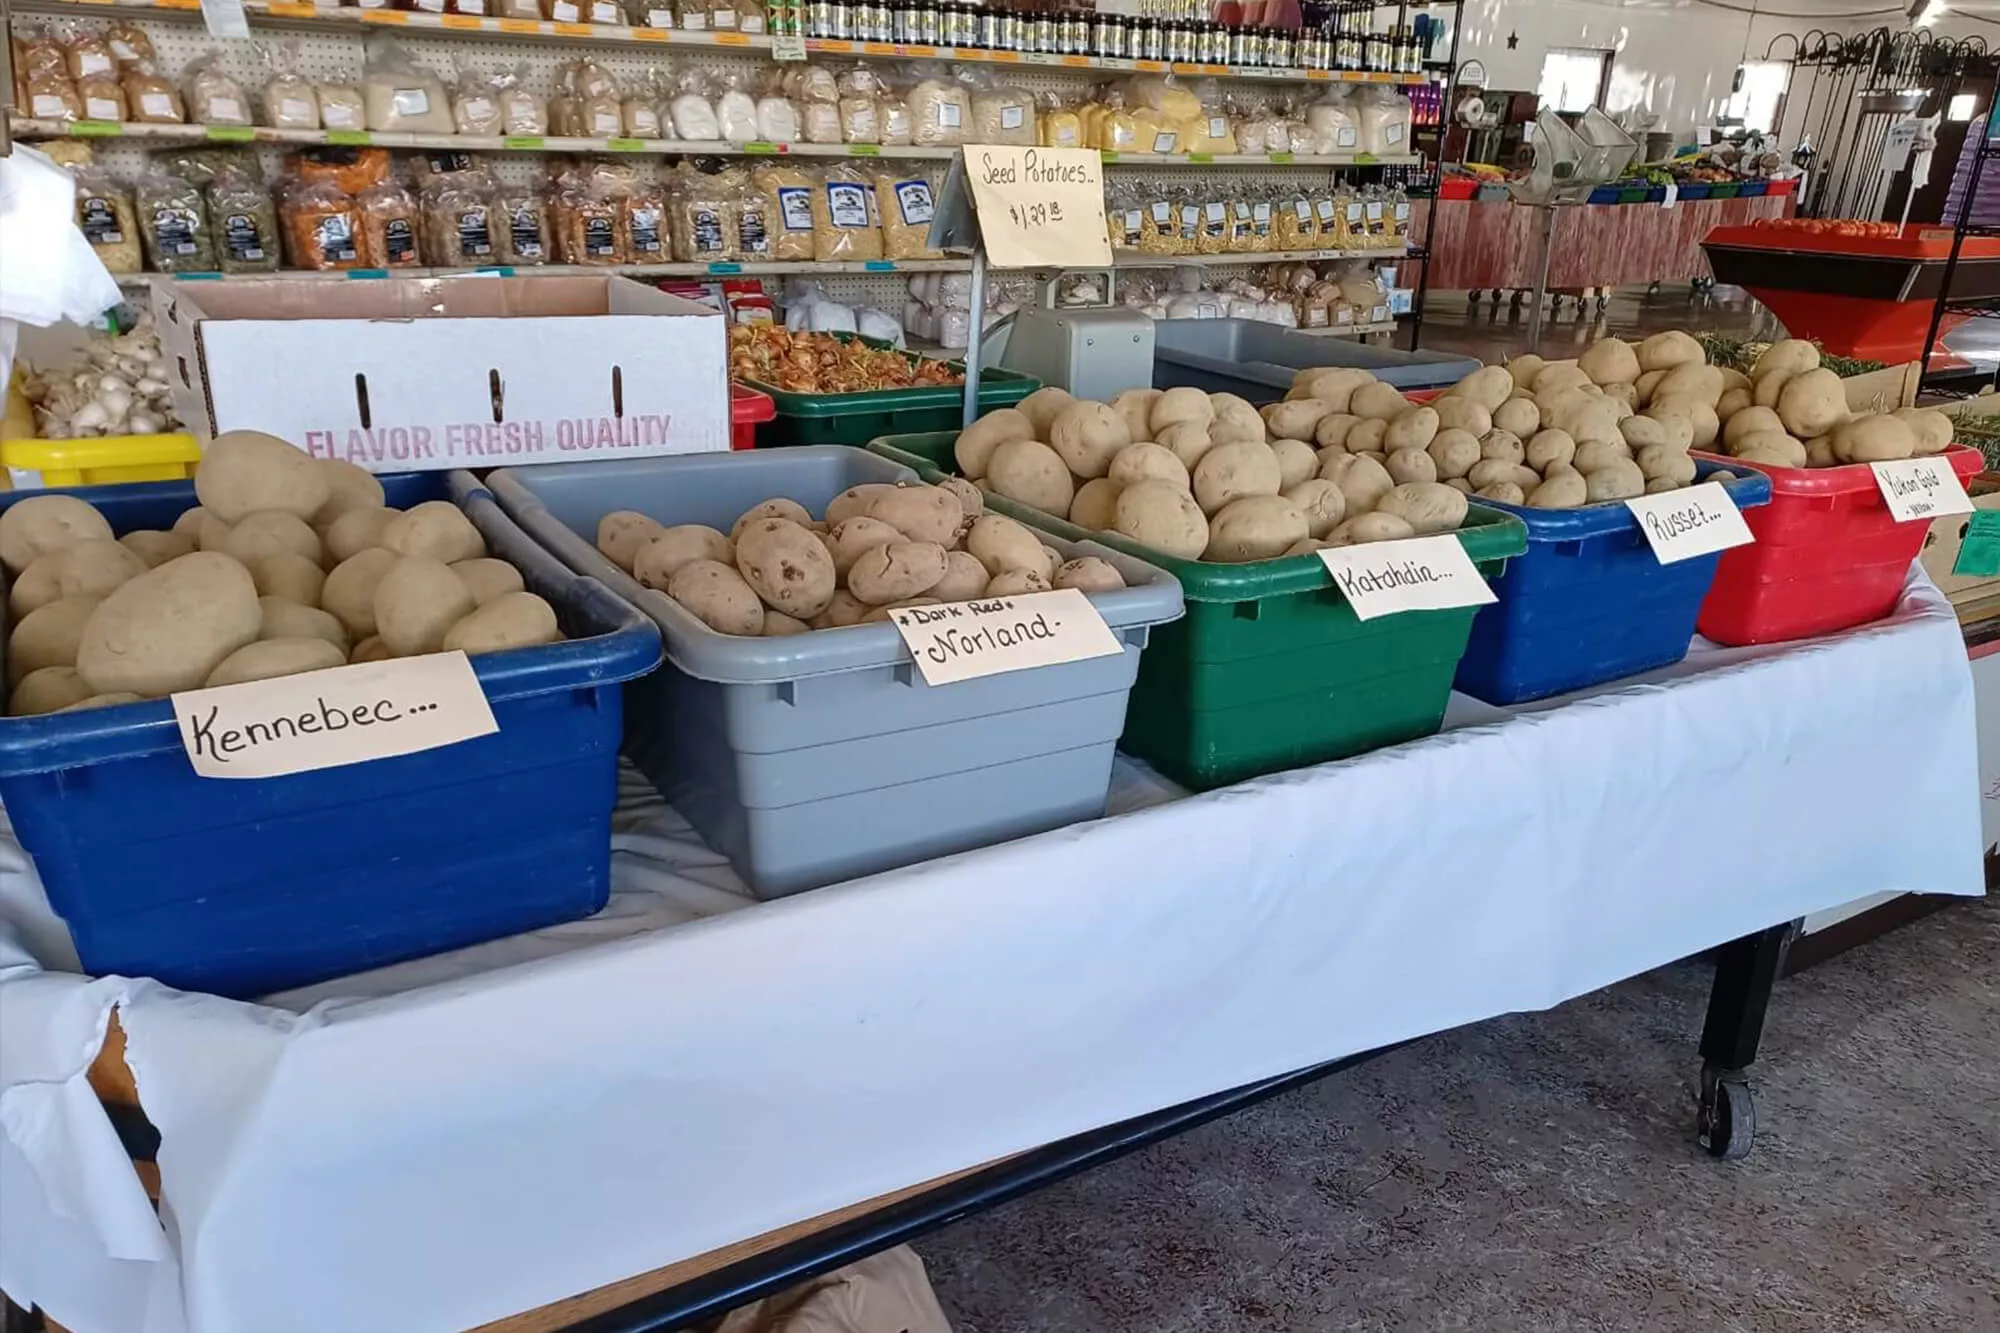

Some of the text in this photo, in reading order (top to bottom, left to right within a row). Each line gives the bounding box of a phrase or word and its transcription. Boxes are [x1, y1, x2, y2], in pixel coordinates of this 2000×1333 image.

[982, 152, 1016, 184] Seed
[305, 414, 671, 463] FLAVOR FRESH QUALITY
[909, 599, 1004, 625] Dark Red
